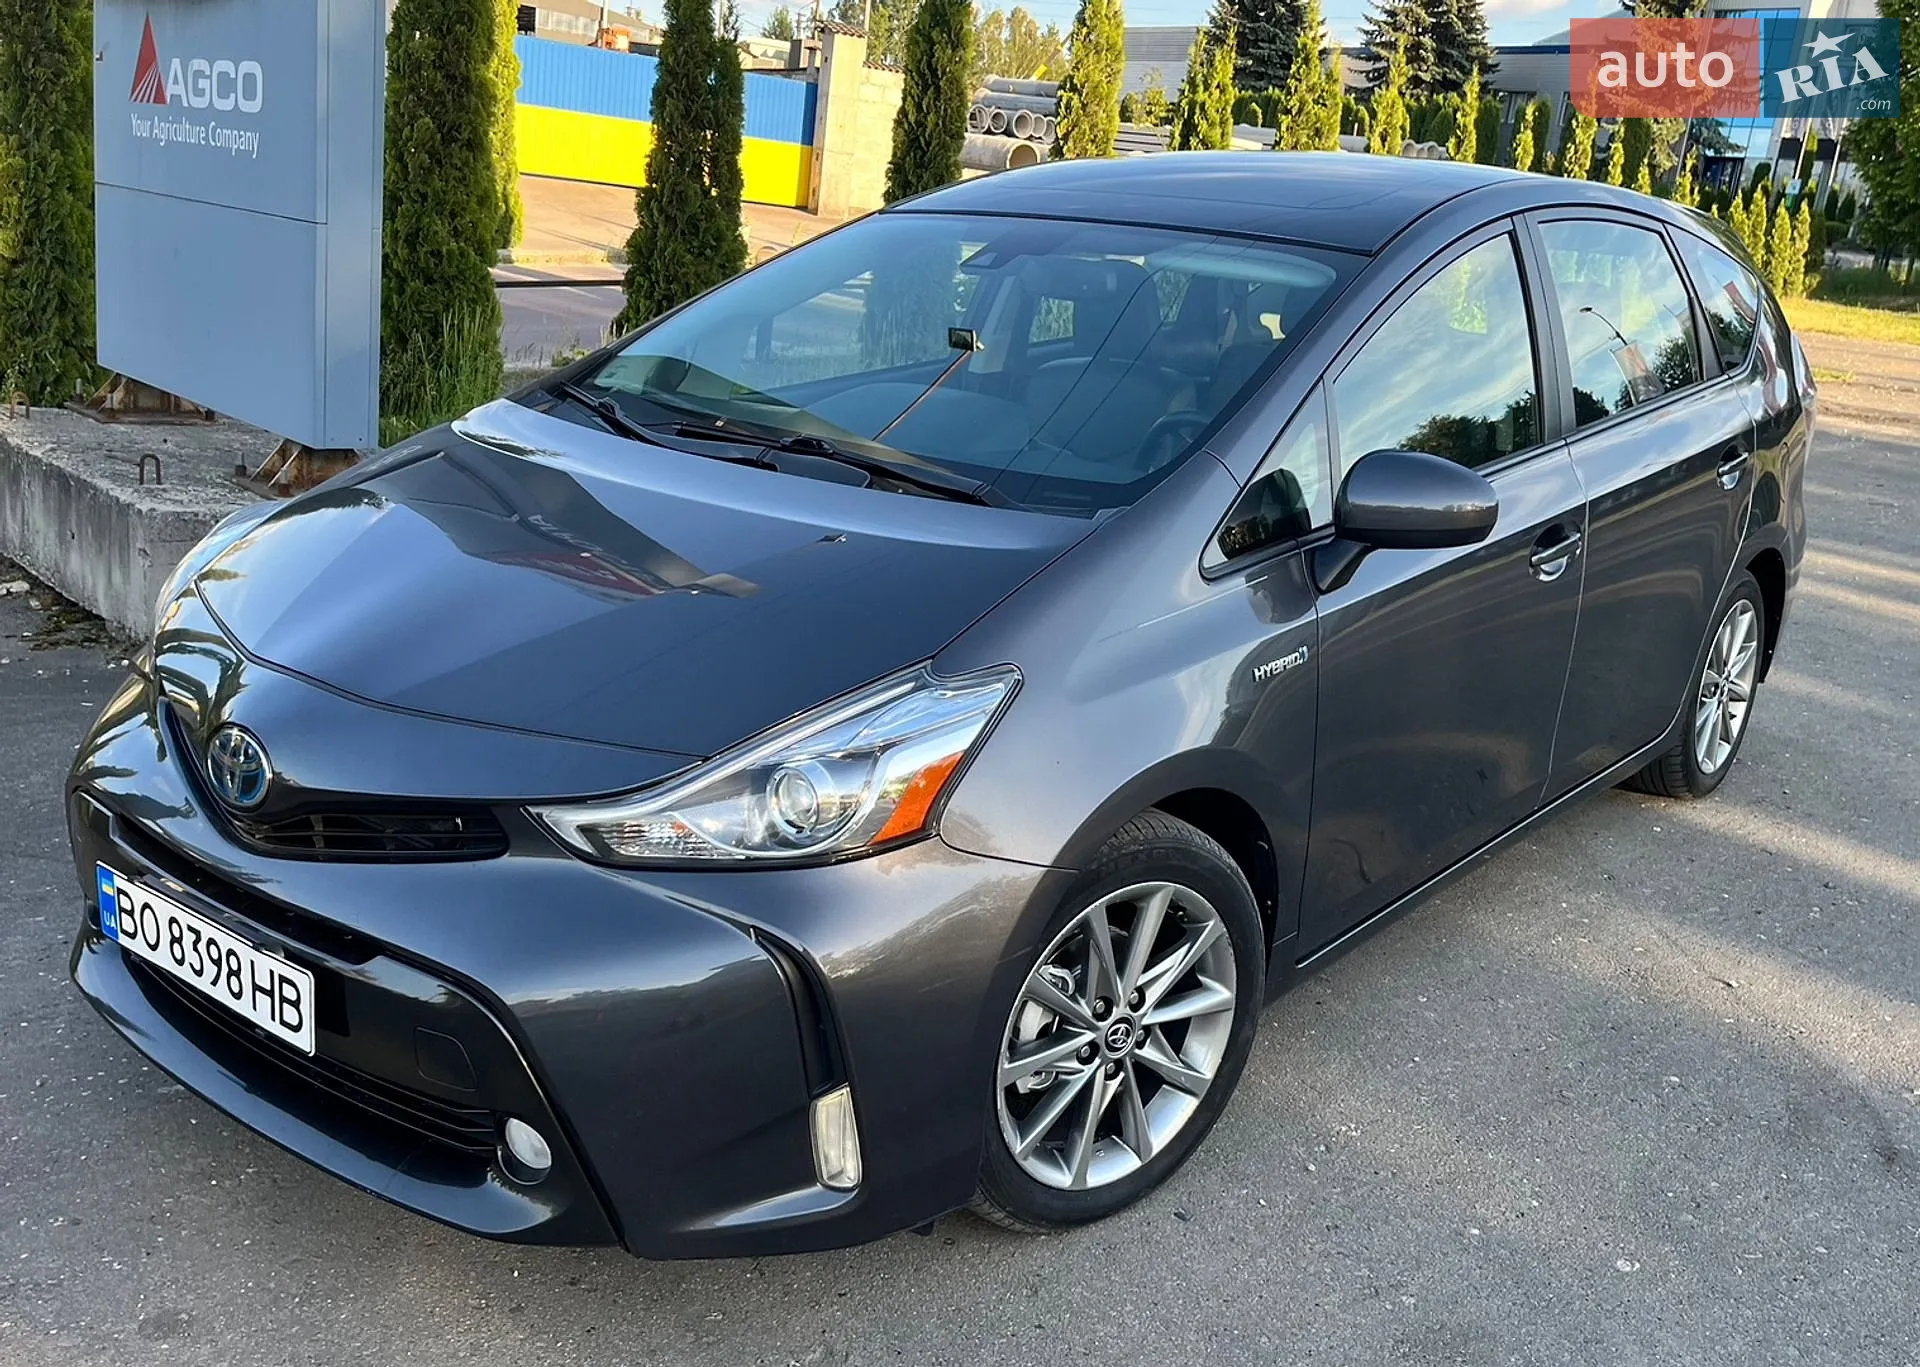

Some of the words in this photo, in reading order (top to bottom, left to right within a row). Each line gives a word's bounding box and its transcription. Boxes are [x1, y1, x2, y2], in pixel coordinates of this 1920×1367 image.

[167, 57, 264, 114] AGCO
[130, 113, 151, 138] Your
[152, 115, 206, 147] Agriculture
[208, 120, 260, 159] Company
[1253, 651, 1301, 682] HYBRID
[103, 910, 117, 931] UA
[116, 886, 161, 952] BO
[168, 915, 244, 1001] 8398
[249, 958, 304, 1033] HB
